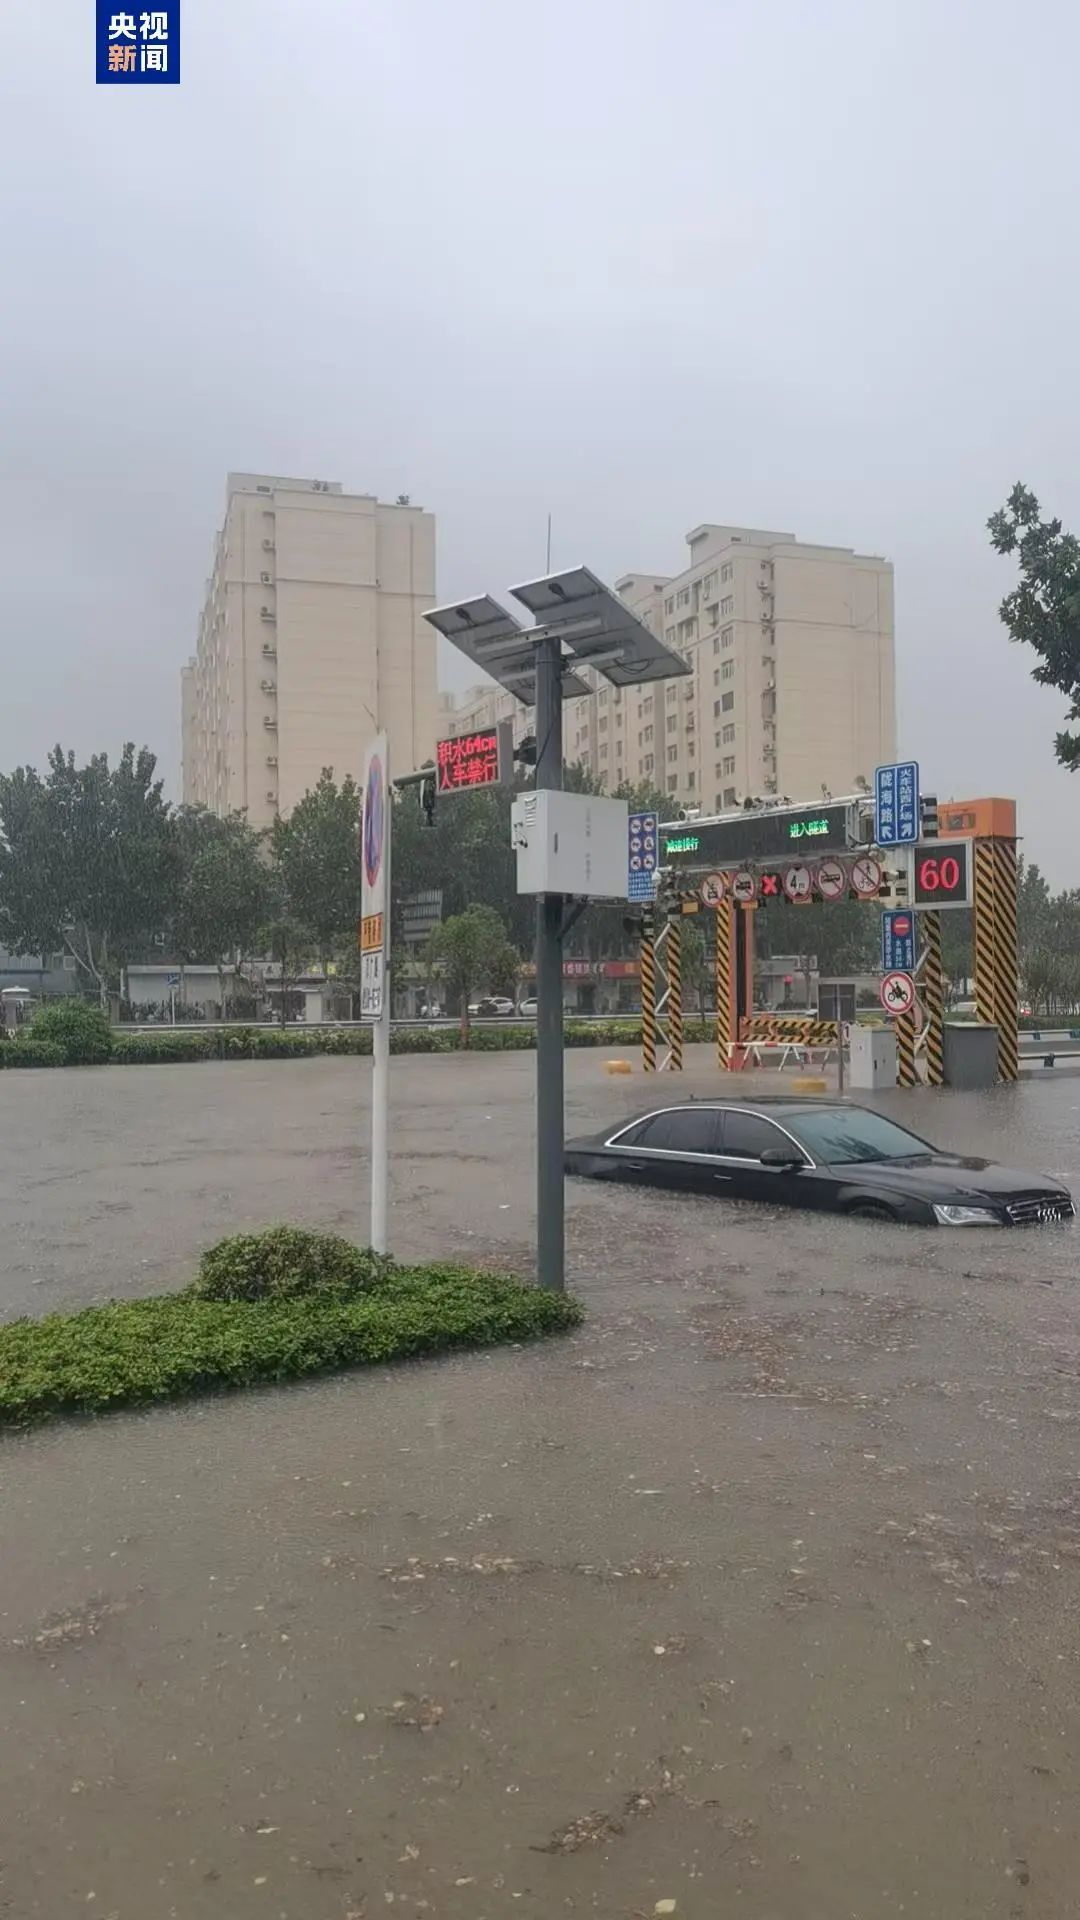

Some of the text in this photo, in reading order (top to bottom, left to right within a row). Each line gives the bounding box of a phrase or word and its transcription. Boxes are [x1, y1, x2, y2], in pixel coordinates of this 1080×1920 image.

[439, 754, 497, 787] 人车禁行
[880, 771, 894, 824] 陇海路
[900, 768, 913, 821] 火车站西广场
[789, 820, 829, 838] 进入隧道
[920, 857, 960, 890] 60
